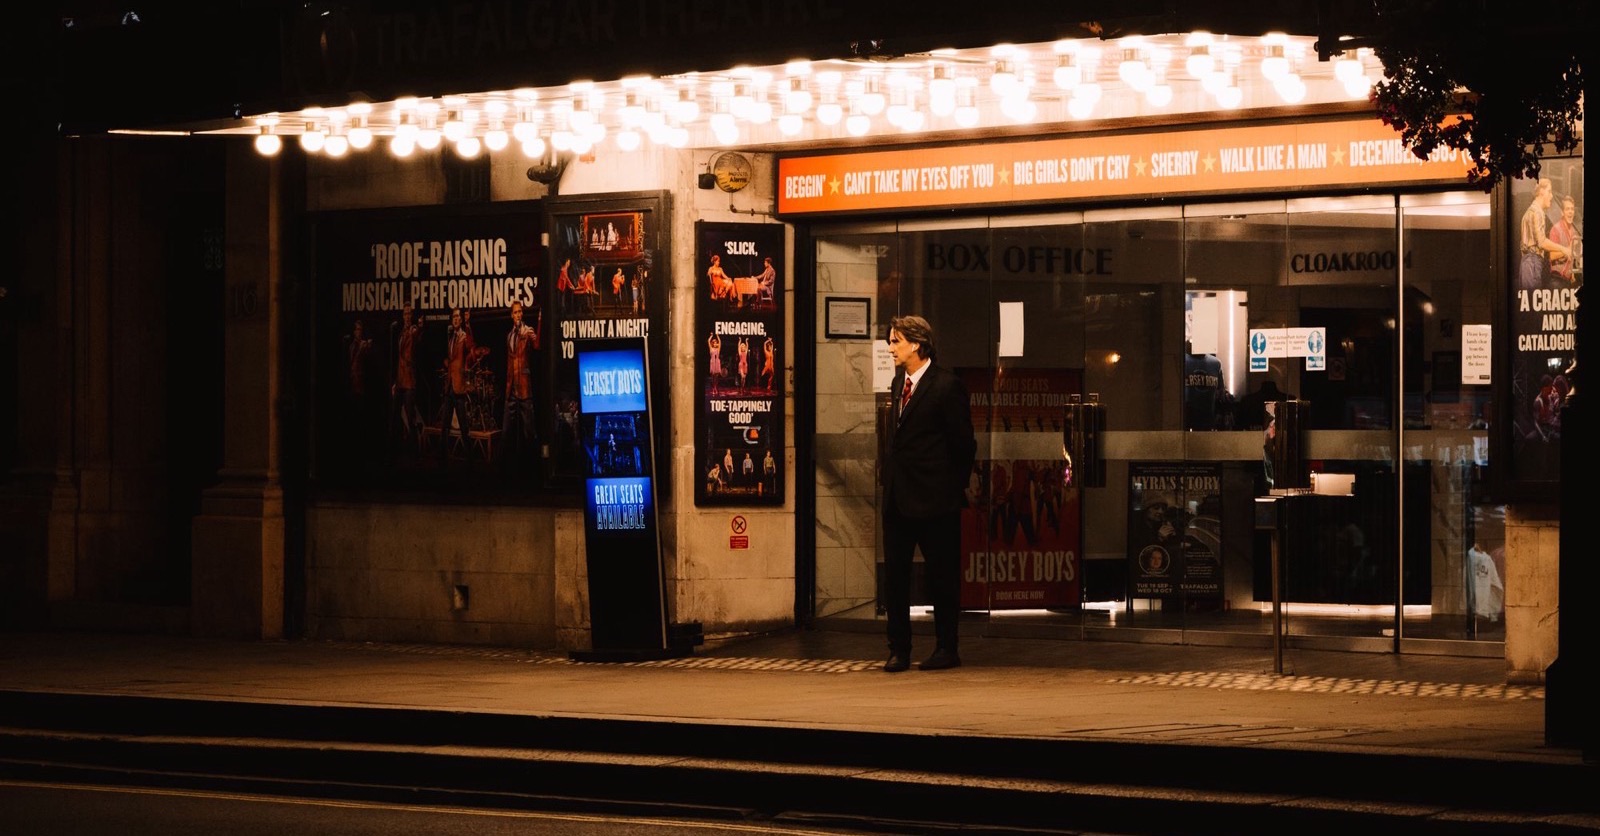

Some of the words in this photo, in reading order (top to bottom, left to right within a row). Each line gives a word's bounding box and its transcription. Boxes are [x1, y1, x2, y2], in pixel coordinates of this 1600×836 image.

[373, 0, 616, 65] TRAFALGAR
[785, 175, 825, 199] BEGGIN'
[844, 171, 872, 196] CANT
[873, 169, 900, 194] TAKE
[902, 168, 919, 192] MY
[921, 166, 948, 191] EYES
[950, 164, 970, 189] OFF
[971, 163, 994, 188] YOU
[1013, 160, 1033, 186] BIG
[1035, 158, 1068, 184] GIRLS
[1070, 155, 1104, 182] DON'T
[1106, 154, 1131, 180] CRY
[1151, 150, 1199, 177] SHERRY
[1219, 147, 1256, 173] WALK
[1257, 144, 1286, 171] LIKE
[1286, 143, 1295, 170] A
[1297, 142, 1327, 169] MAN
[371, 237, 507, 280] 'ROOF-RAISING
[724, 241, 758, 256] 'SLICK,
[927, 243, 991, 272] BOX
[1003, 245, 1113, 275] OFFICE
[342, 280, 404, 313] MUSICAL
[410, 277, 538, 310] PERFORMANCES'
[560, 319, 577, 339] 'OH
[578, 319, 606, 338] WHAT
[607, 319, 614, 338] A
[615, 317, 649, 337] NIGHT!
[715, 321, 767, 337] ENGAGING,
[1542, 314, 1564, 331] AND
[583, 371, 616, 396] JERSEY
[617, 369, 642, 394] BOYS
[1021, 378, 1049, 392] SEATS
[710, 400, 772, 413] TOE-TAPPINGLY
[970, 392, 1020, 406] AVALABLE
[1022, 393, 1039, 407] FOR
[728, 412, 754, 424] GOOD'
[1132, 475, 1177, 490] MYRA'S
[595, 485, 618, 504] GREAT
[620, 484, 643, 504] SEATS
[596, 504, 646, 530] AVAILABLE
[964, 550, 1028, 584] JERSEY
[1032, 550, 1075, 584] BOYS
[1013, 590, 1029, 600] HERE
